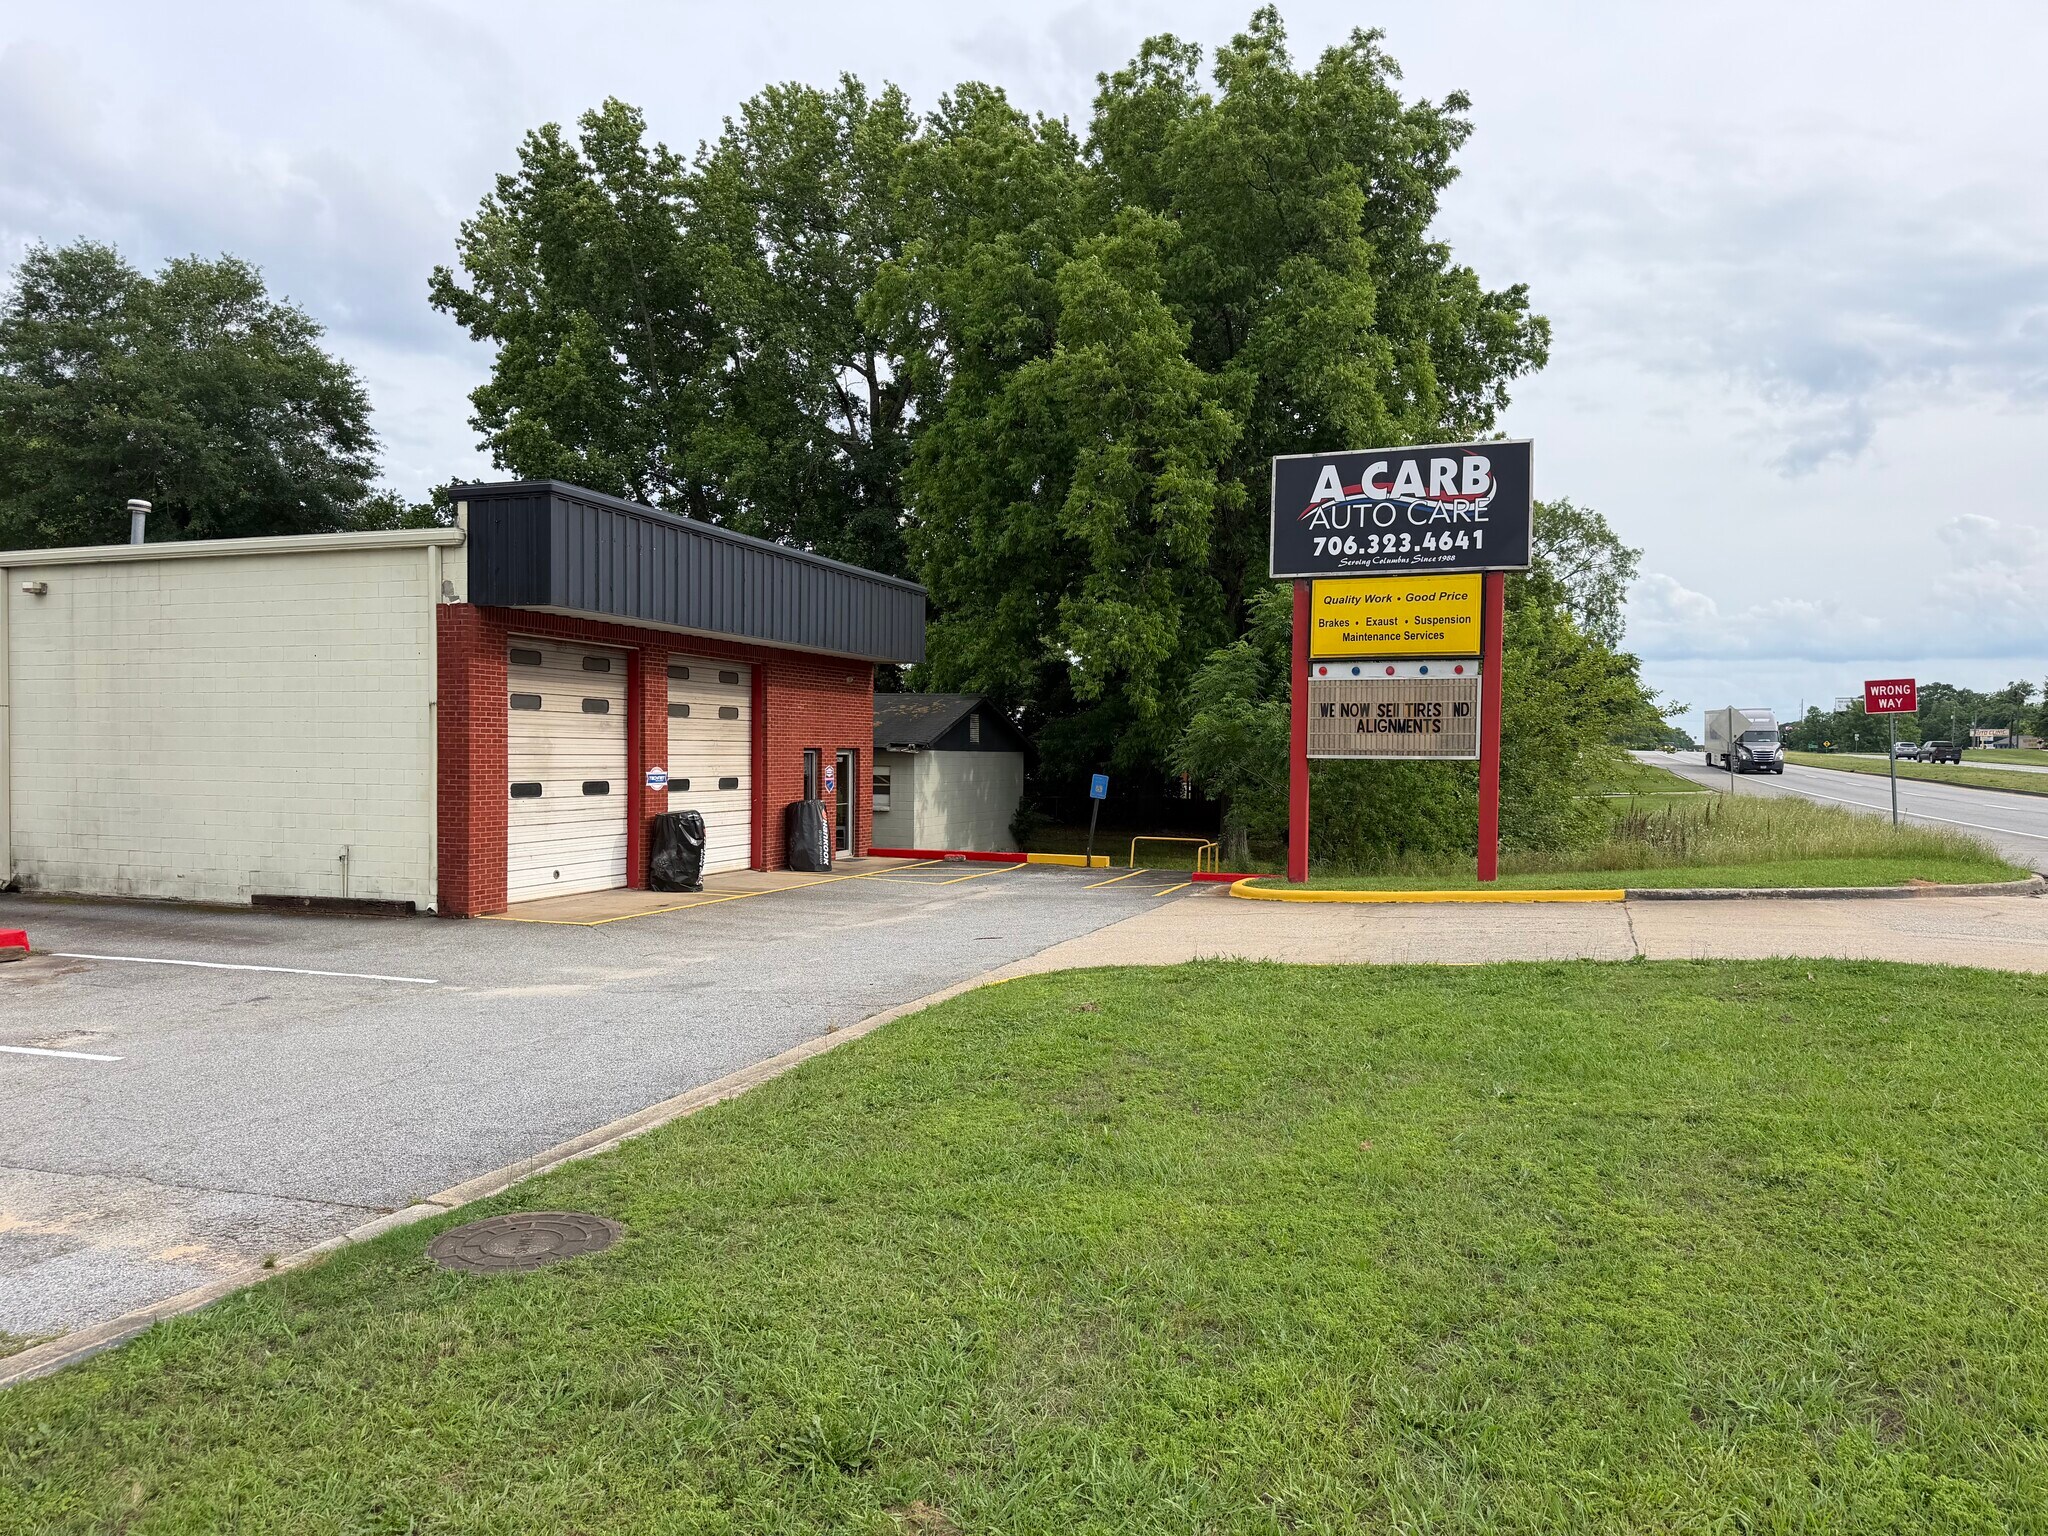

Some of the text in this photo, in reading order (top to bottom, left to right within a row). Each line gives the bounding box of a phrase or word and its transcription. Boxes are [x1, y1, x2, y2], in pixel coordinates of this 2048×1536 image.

[1310, 456, 1491, 503] A CARB
[1309, 497, 1489, 530] AUTO CARE
[1313, 529, 1483, 557] 706.323.4641
[1338, 557, 1371, 567] Serving
[1372, 555, 1410, 565] Columbus
[1411, 554, 1437, 564] Since
[1323, 591, 1468, 606] Quality Work Good Price
[1318, 615, 1471, 628] Brakes Exaust Suspension
[1342, 630, 1445, 642] Maintenance Services
[1870, 684, 1911, 696] WRONG
[1320, 703, 1335, 718] WE
[1340, 703, 1370, 718] NOW
[1405, 703, 1442, 718] TIRES
[1453, 702, 1470, 717] ND
[1878, 698, 1903, 709] WAY
[1356, 719, 1442, 733] ALIGNMENTS
